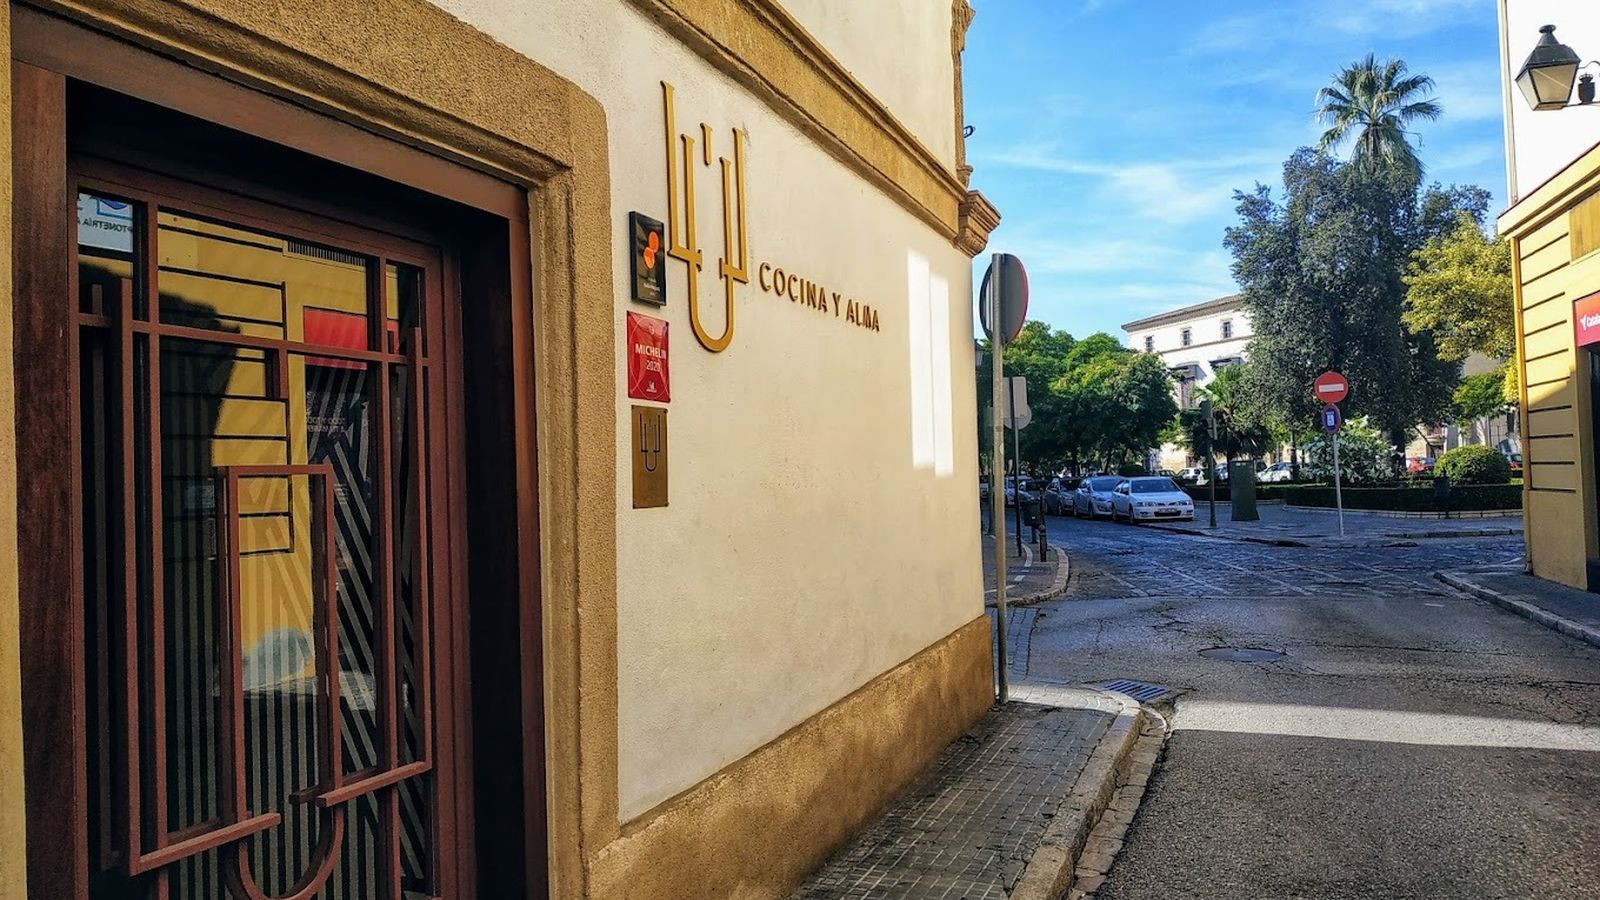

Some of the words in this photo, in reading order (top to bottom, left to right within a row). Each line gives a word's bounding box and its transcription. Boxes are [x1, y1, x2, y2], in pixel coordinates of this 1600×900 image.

[759, 262, 827, 313] COCINA
[832, 292, 841, 317] Y
[846, 299, 880, 333] ALMA
[635, 343, 667, 360] MICHELIN
[646, 360, 661, 373] 2020
